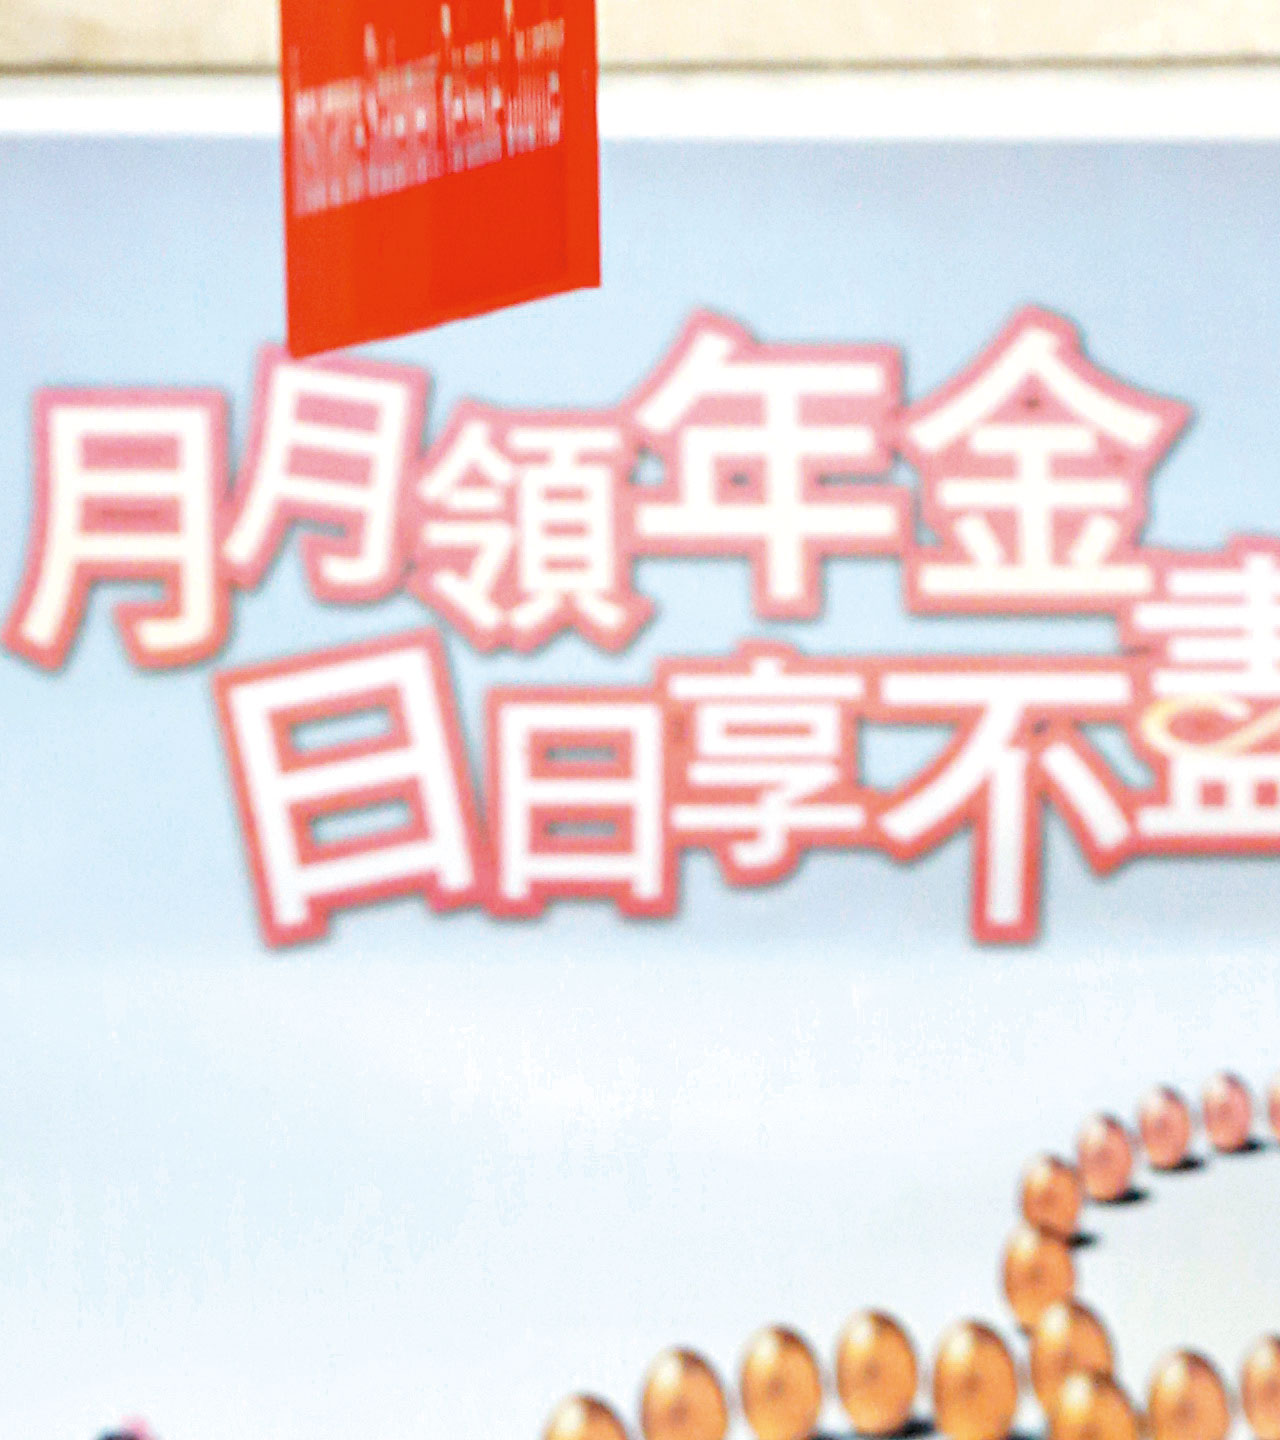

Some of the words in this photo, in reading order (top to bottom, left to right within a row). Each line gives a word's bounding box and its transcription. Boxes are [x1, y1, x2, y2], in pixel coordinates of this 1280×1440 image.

[3, 307, 1187, 668] 月月領年金
